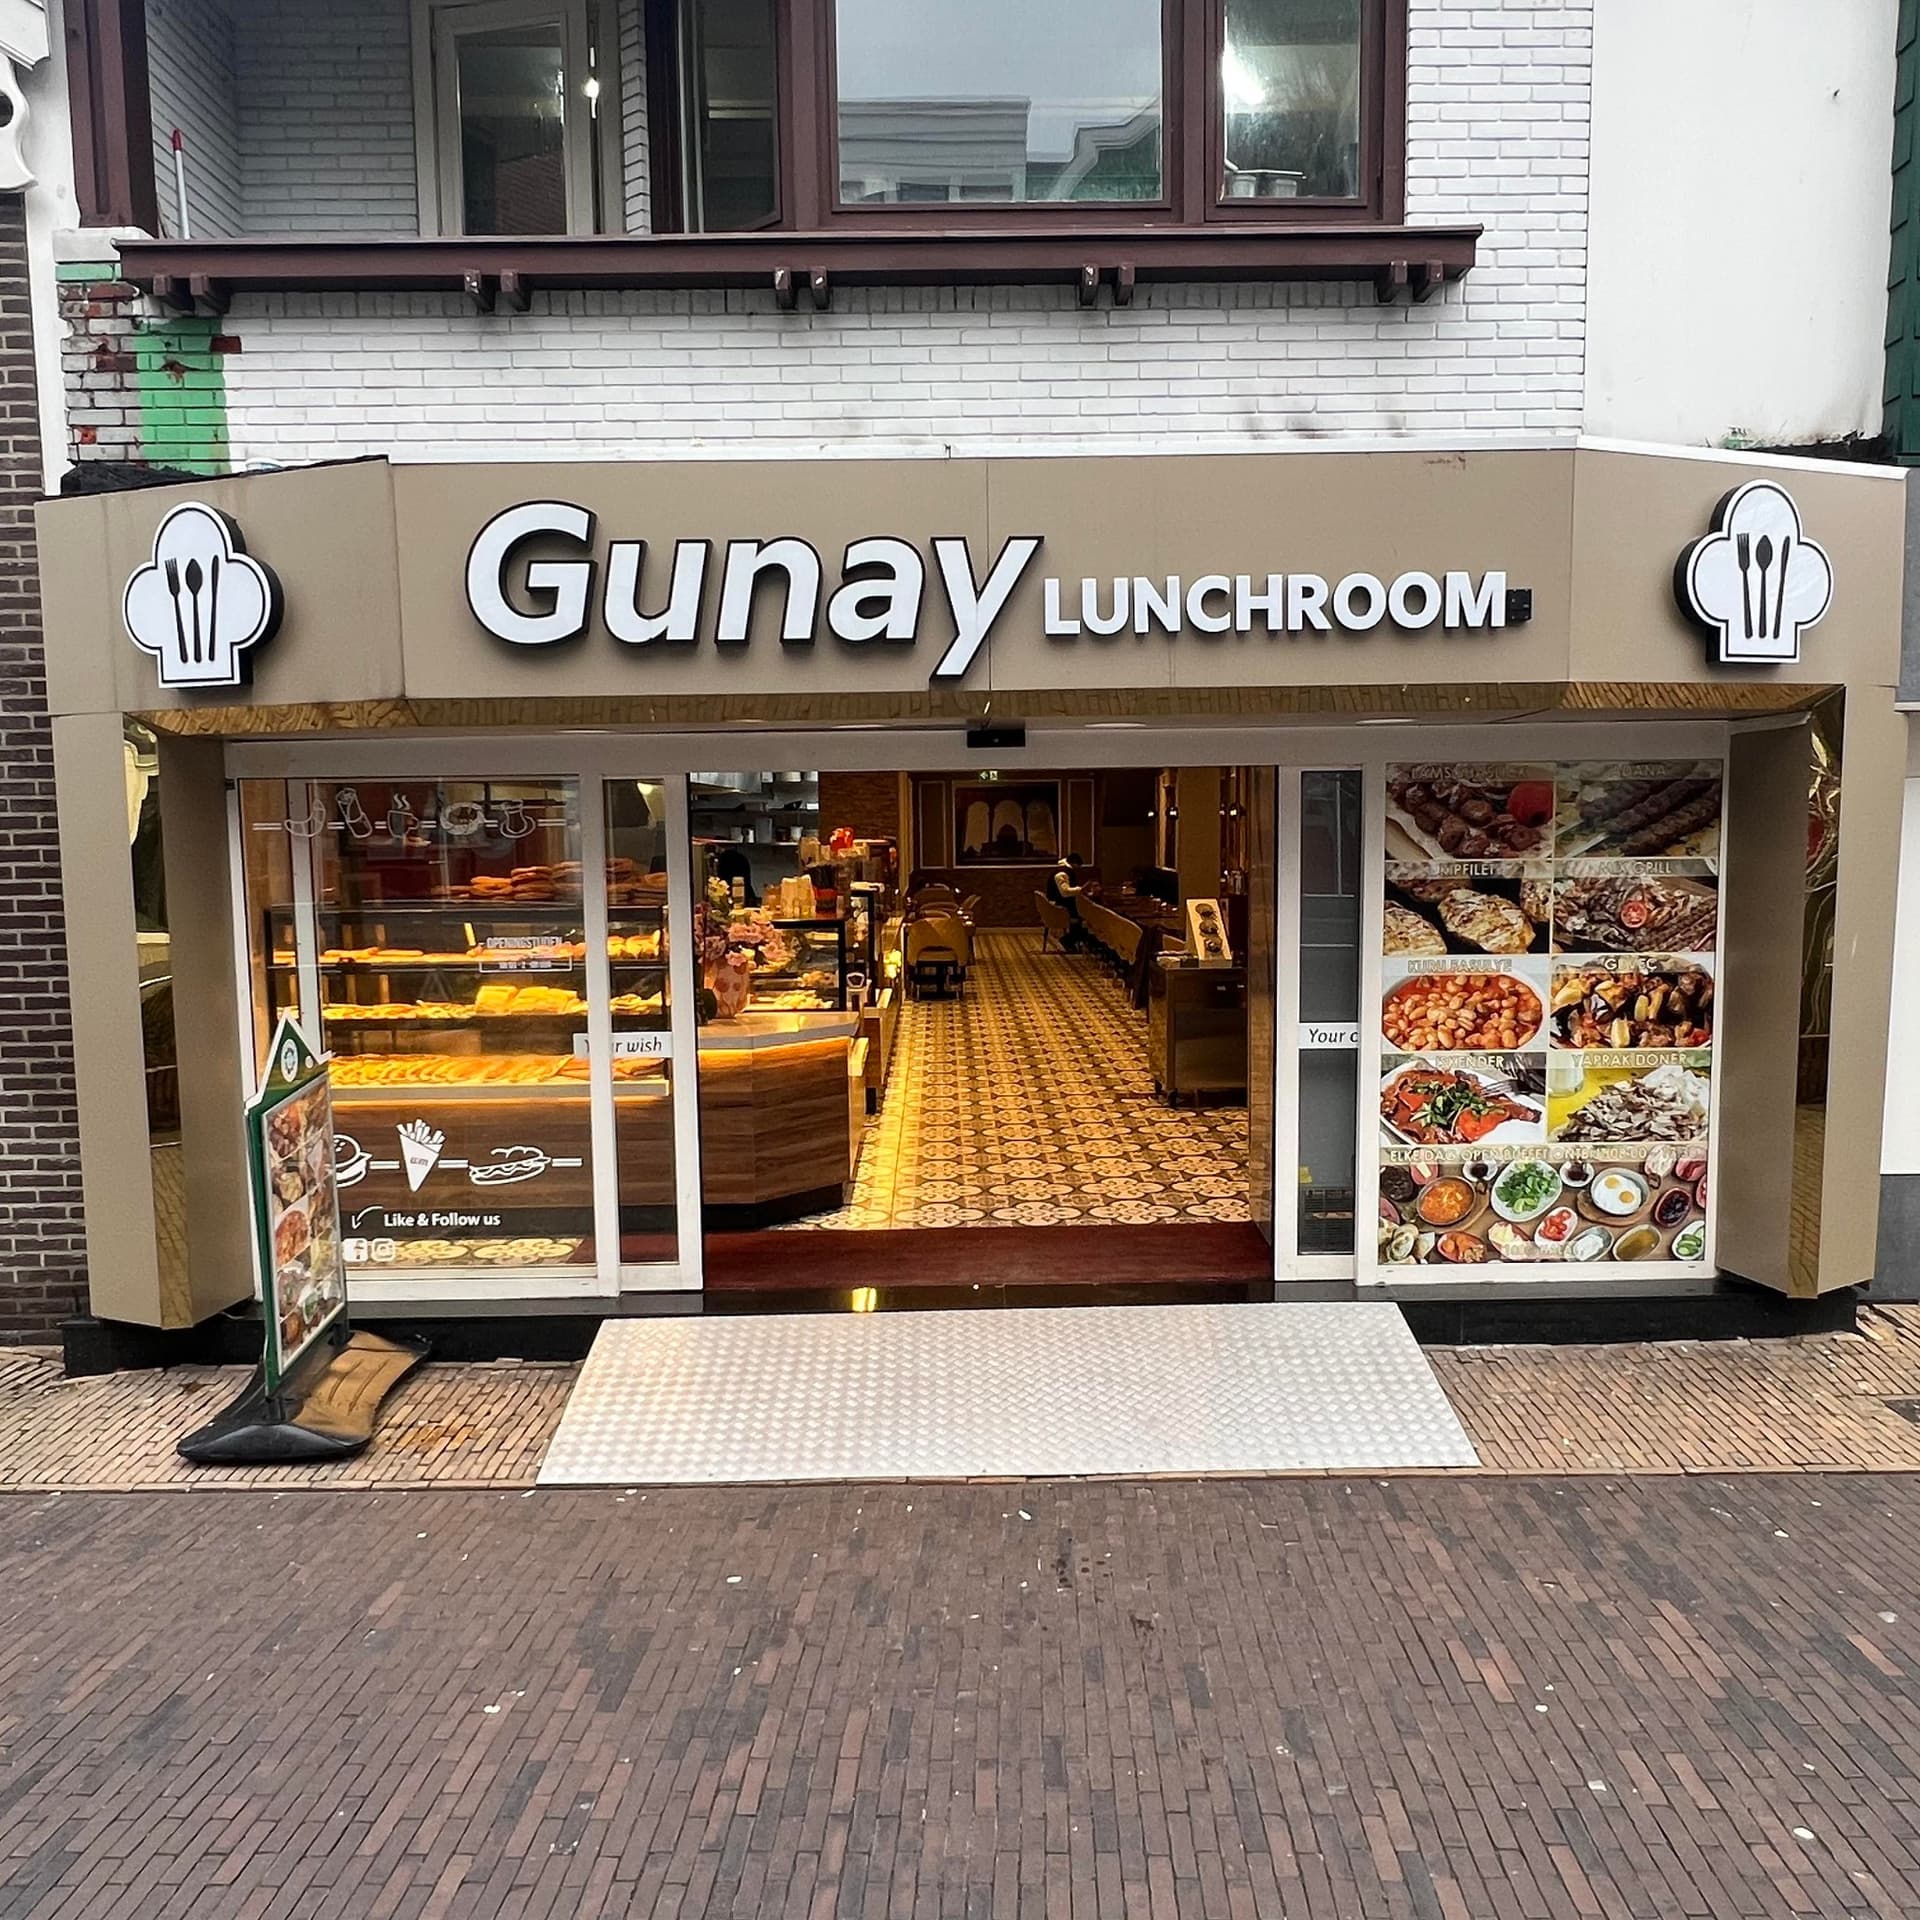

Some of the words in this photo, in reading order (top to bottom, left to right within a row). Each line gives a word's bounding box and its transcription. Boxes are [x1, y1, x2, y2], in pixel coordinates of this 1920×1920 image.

[465, 500, 1044, 682] Gunay
[1043, 571, 1508, 637] LUNCHROOM
[1634, 861, 1672, 874] GRILL
[1309, 1028, 1346, 1043] Your
[626, 1036, 662, 1053] wish
[1571, 1054, 1630, 1068] YAPRAK
[1389, 1150, 1420, 1162] ELKE
[1424, 1149, 1456, 1161] DAG
[384, 1212, 415, 1227] Like
[416, 1212, 429, 1226] &
[431, 1212, 481, 1226] Follow
[483, 1214, 502, 1226] us
